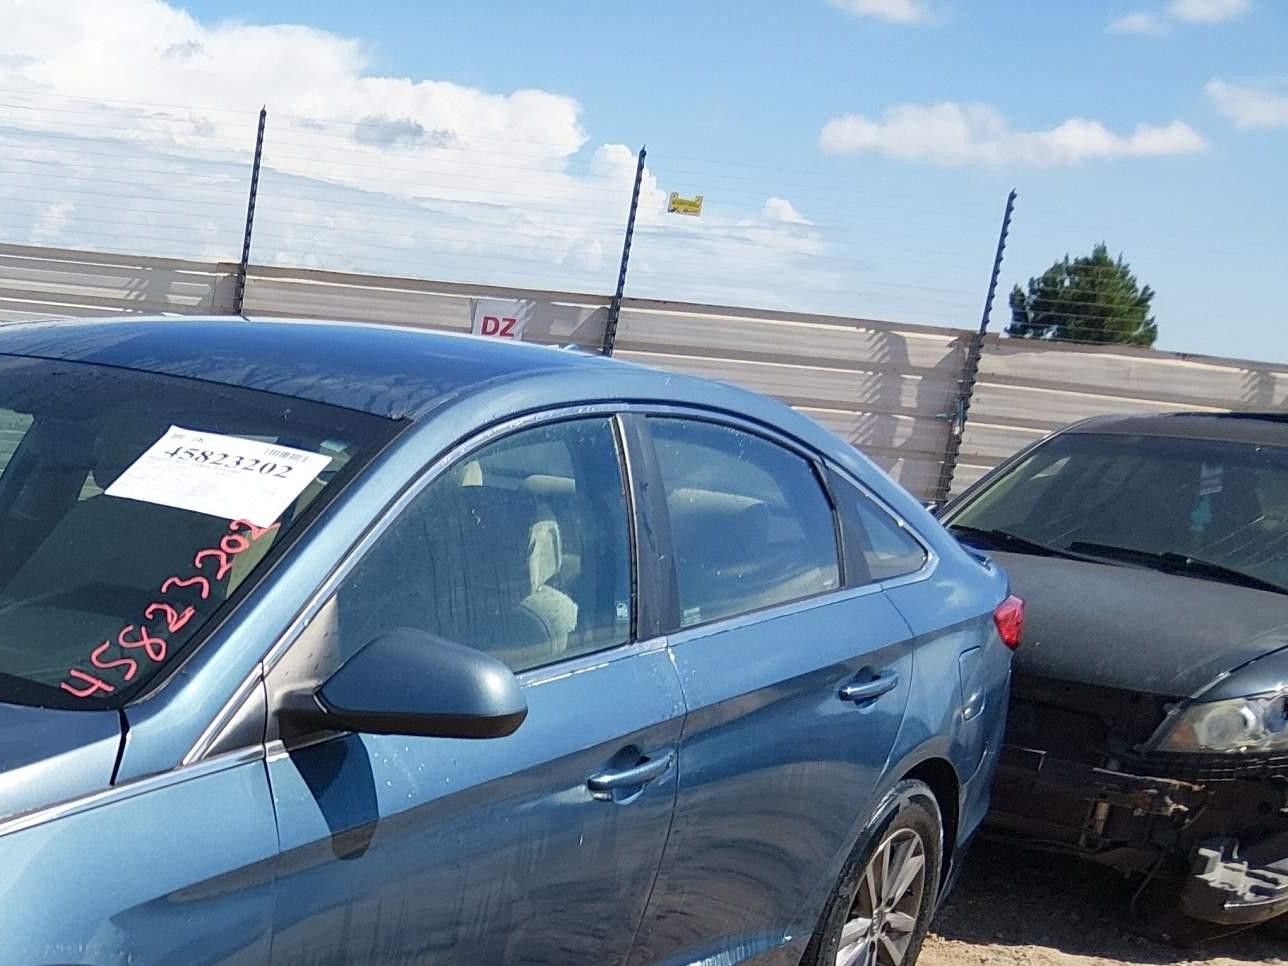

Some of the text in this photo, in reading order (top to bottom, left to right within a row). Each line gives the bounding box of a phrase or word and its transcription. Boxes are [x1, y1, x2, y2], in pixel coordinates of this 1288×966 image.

[481, 316, 517, 337] DZ
[164, 446, 293, 479] 45823202
[61, 519, 281, 697] 45823202
